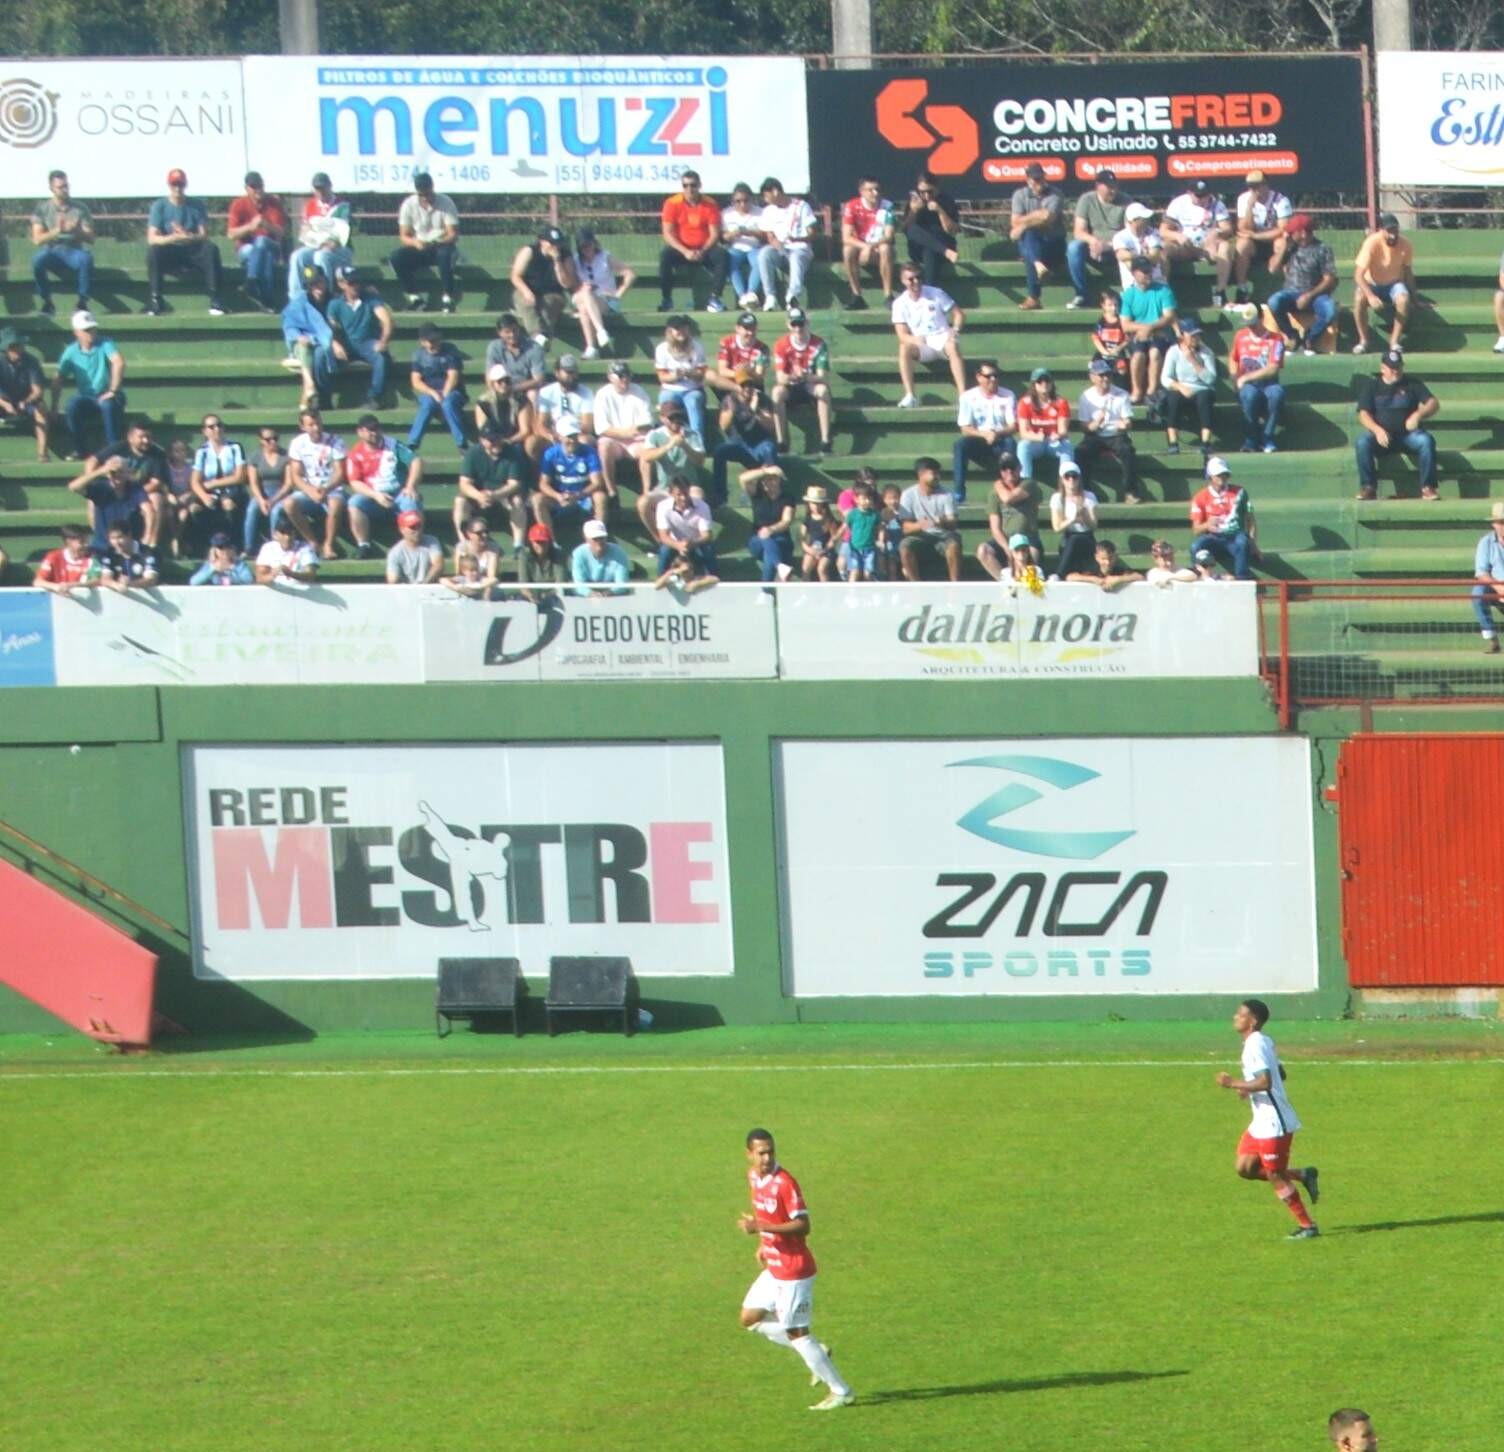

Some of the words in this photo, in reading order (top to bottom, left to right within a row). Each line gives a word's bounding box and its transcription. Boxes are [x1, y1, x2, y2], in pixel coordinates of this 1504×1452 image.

[323, 71, 387, 84] FILTROS
[392, 71, 414, 84] DE
[419, 68, 465, 84] ÁGUA
[472, 71, 481, 84] E
[486, 68, 567, 84] COLCHÕES
[80, 89, 231, 101] MADEIRAS
[77, 103, 234, 136] OSSANI
[318, 65, 731, 157] menuzzi
[992, 92, 1283, 136] CONCREFRED
[994, 135, 1082, 154] Concreto
[1084, 133, 1158, 151] Usinado
[1178, 135, 1197, 149] 55
[1199, 132, 1277, 148] 3744-7422
[450, 164, 491, 181] 1406
[573, 615, 634, 643] DEDO
[637, 614, 712, 643] VERDE
[897, 603, 1015, 644] dalla
[1029, 612, 1139, 643] nora
[920, 664, 1017, 675] ARQUITETURA
[208, 786, 350, 827] REDE
[212, 819, 721, 933] MESTRE
[921, 869, 1170, 938] ZACA
[923, 948, 1152, 978] SPORTS
